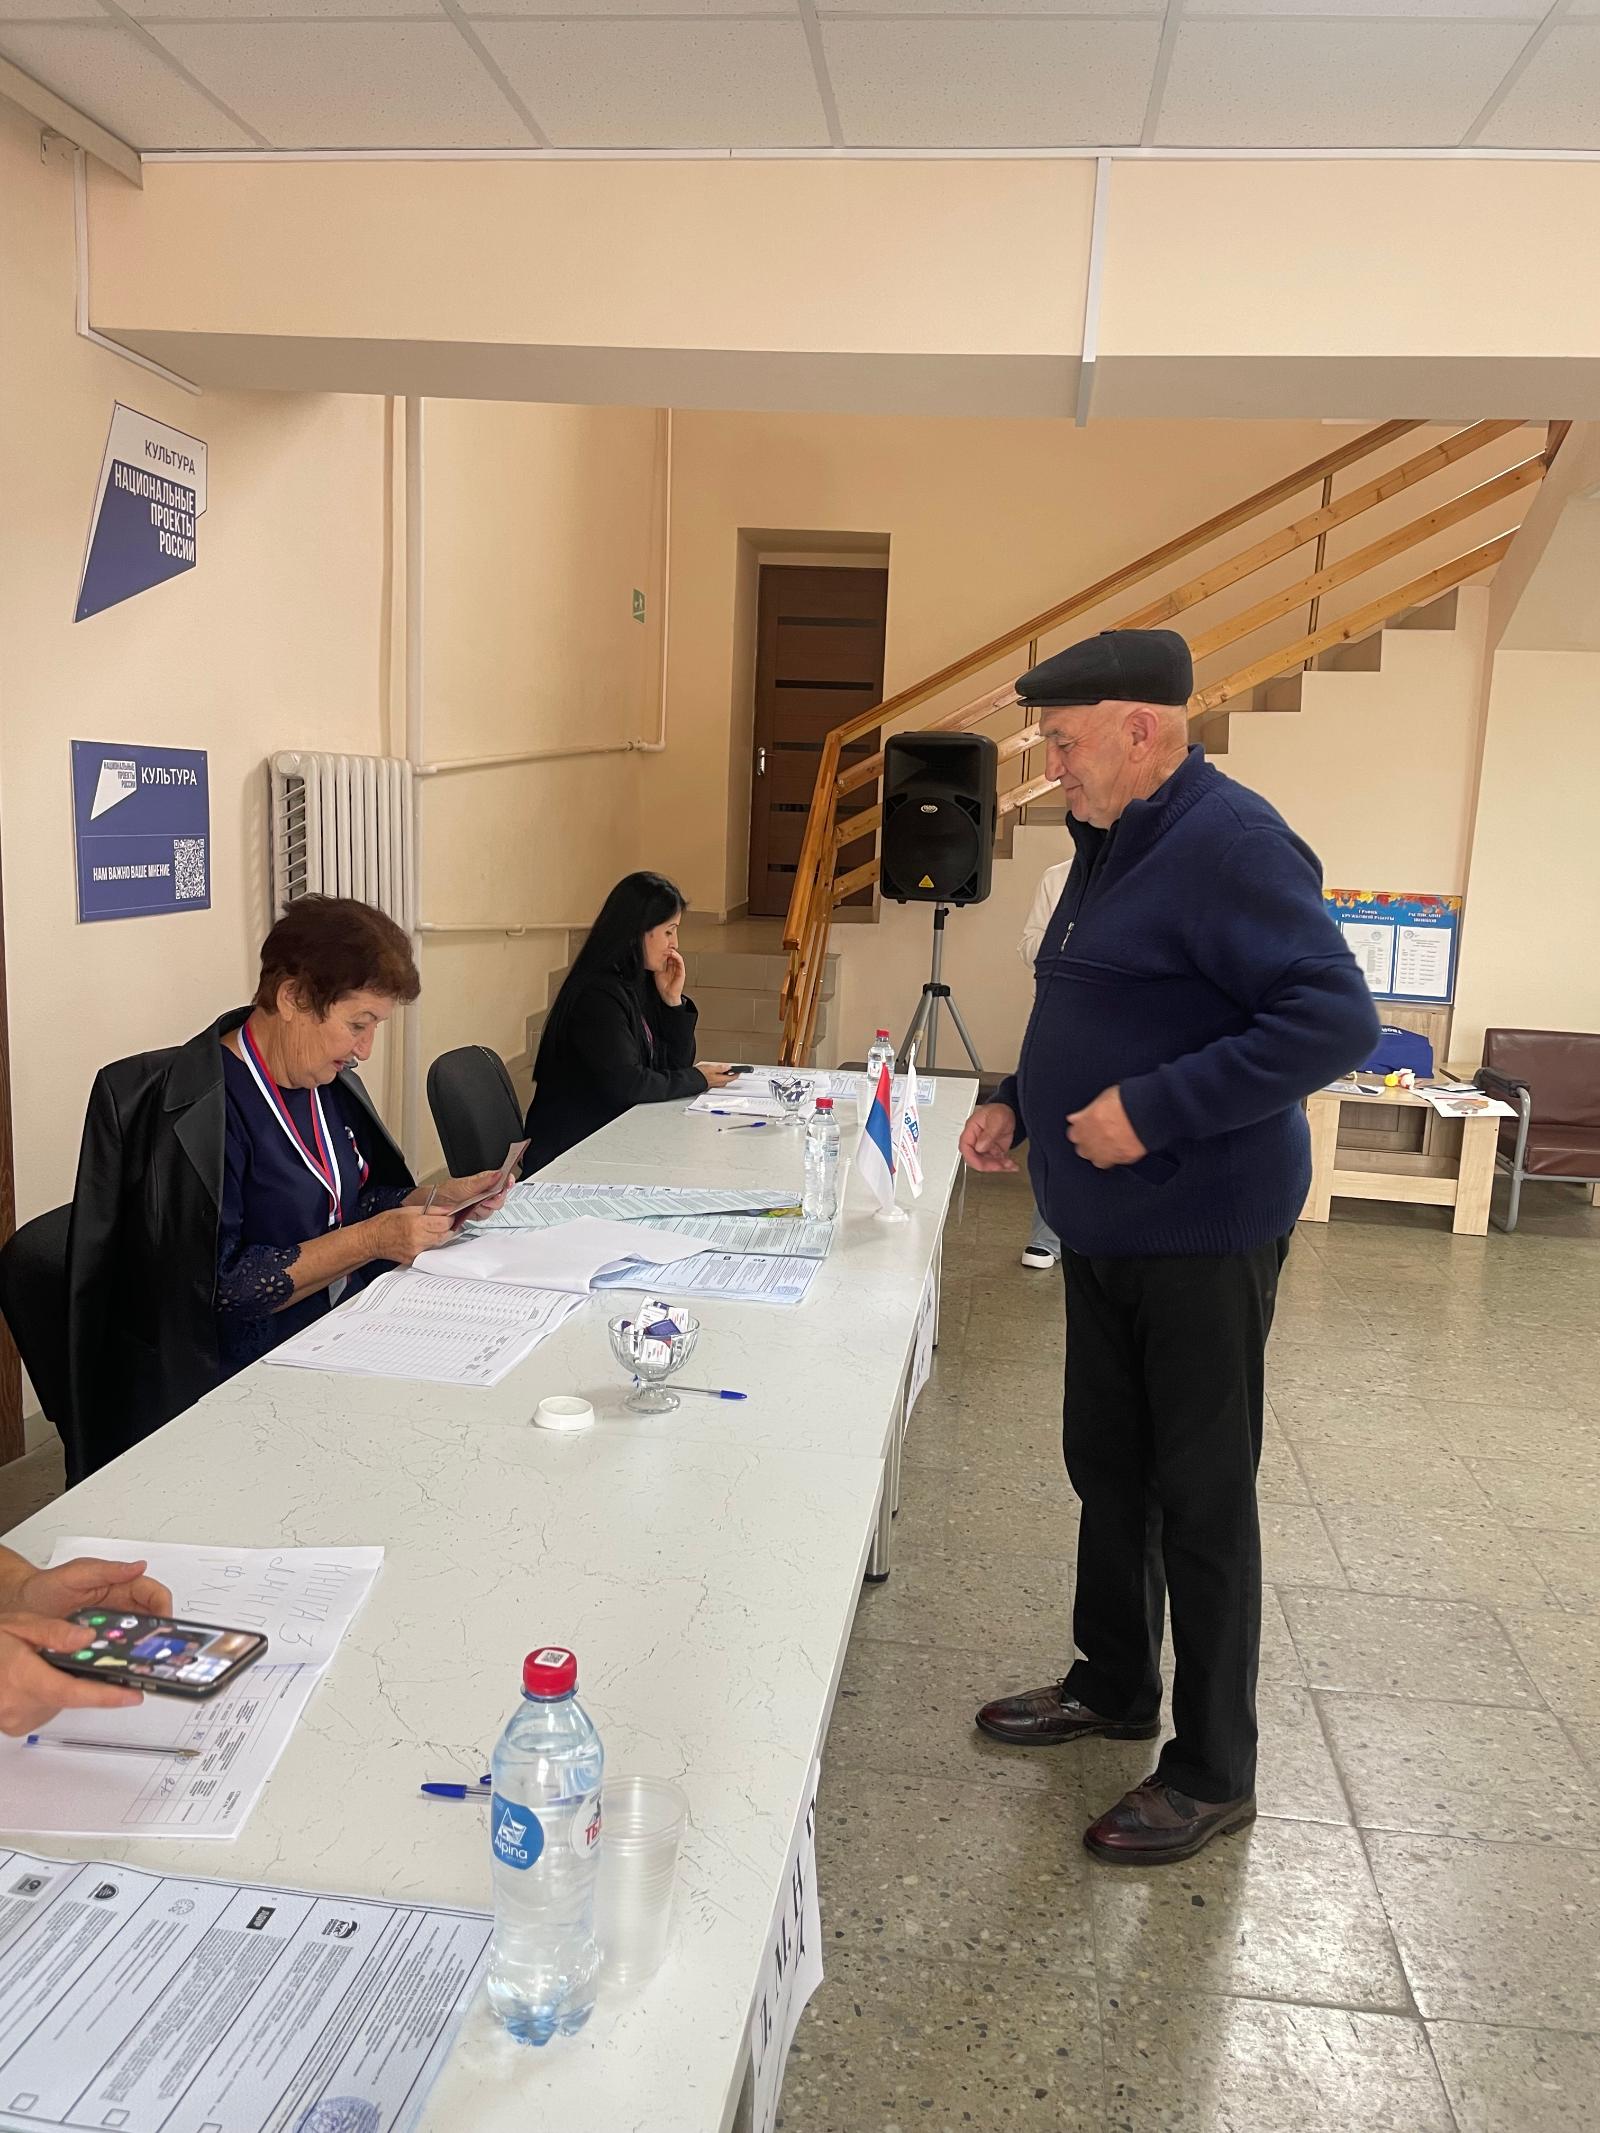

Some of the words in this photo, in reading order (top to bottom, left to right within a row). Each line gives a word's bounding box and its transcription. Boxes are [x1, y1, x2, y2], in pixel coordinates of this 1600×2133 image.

[144, 439, 196, 475] КУЛЬТУРА
[114, 463, 194, 514] НАЦИОНАЛЬНЫЕ
[150, 502, 194, 538] ПРОЕКТЫ
[159, 530, 195, 562] РОССИИ
[141, 766, 197, 786] КУЛЬТУРА
[93, 867, 107, 881] НАМ
[108, 866, 131, 880] ВАЖНО
[131, 865, 147, 879] ВАШЕ
[148, 863, 170, 878] МНЕНИЕ
[288, 1563, 352, 1622] КНИГА
[494, 1839, 528, 1860] Alpina
